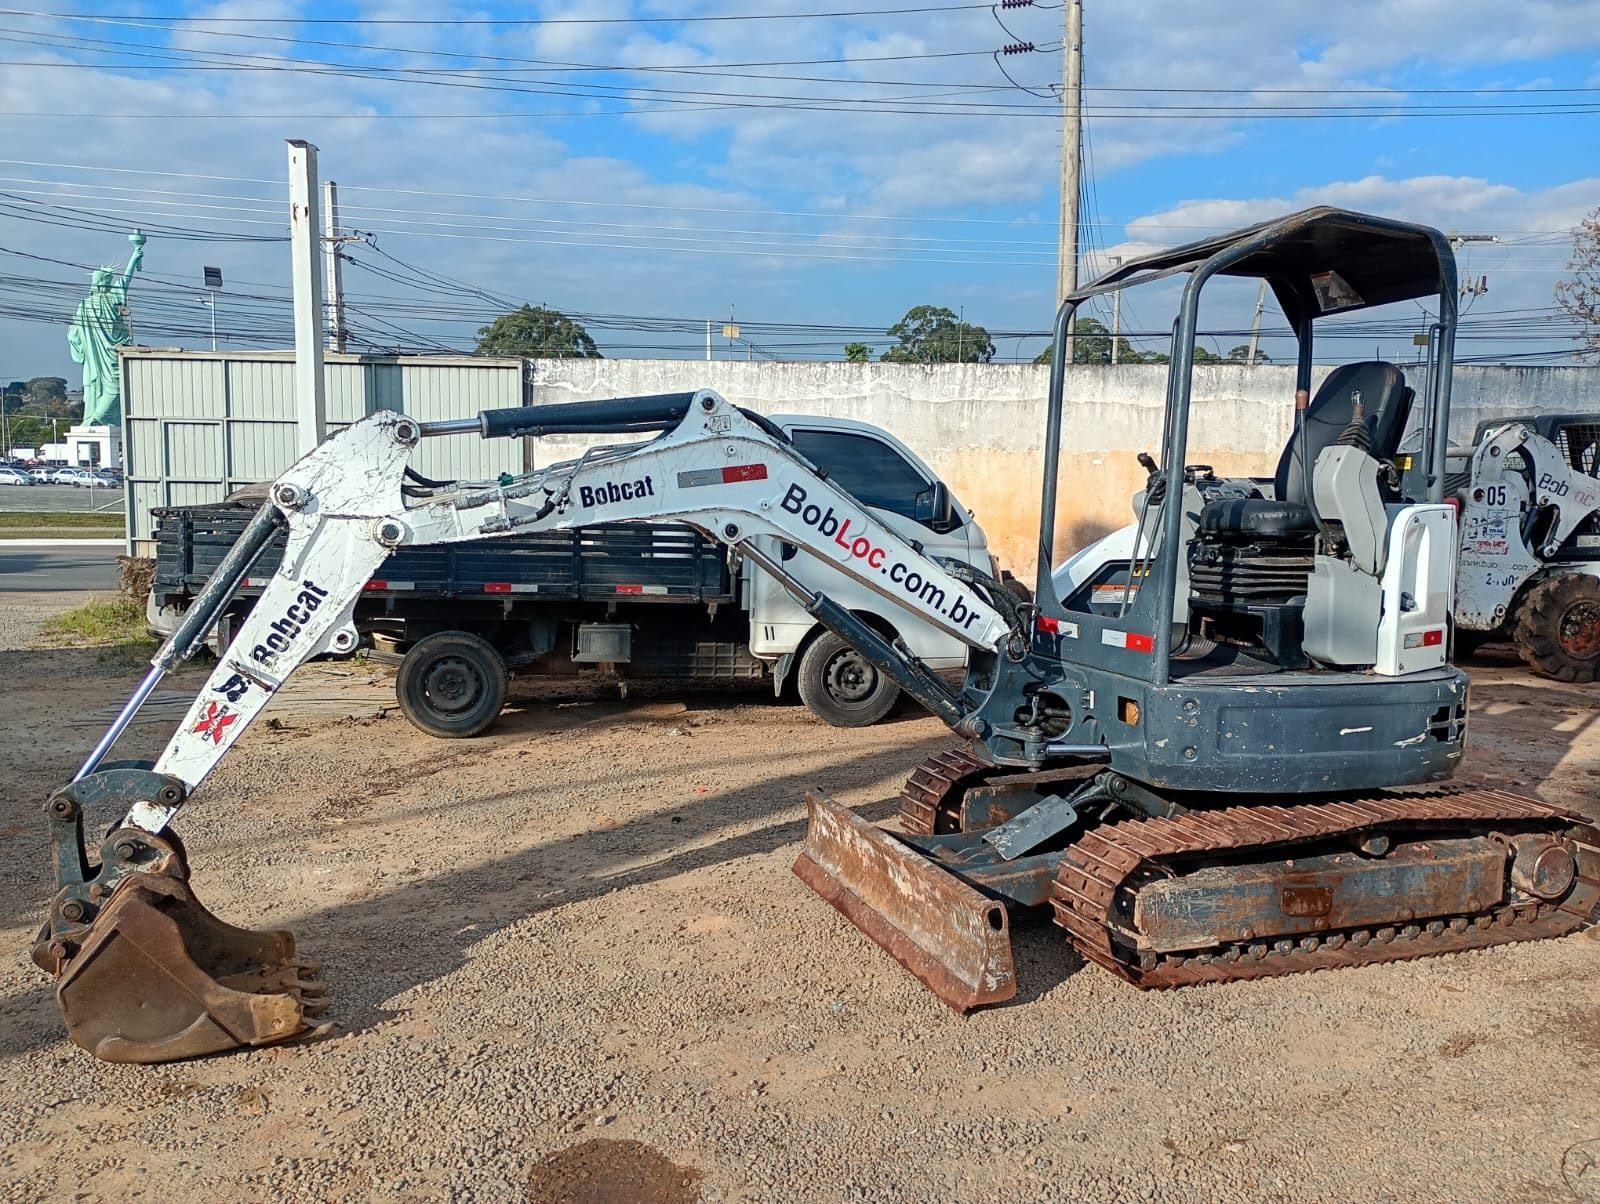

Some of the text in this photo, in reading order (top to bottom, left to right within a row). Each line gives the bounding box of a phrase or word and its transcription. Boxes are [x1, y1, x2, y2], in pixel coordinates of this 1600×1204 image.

[580, 476, 654, 508] Bobcat
[1487, 486, 1506, 506] 05
[780, 483, 981, 630] BobLoc.com.br
[250, 580, 328, 667] Bobcat
